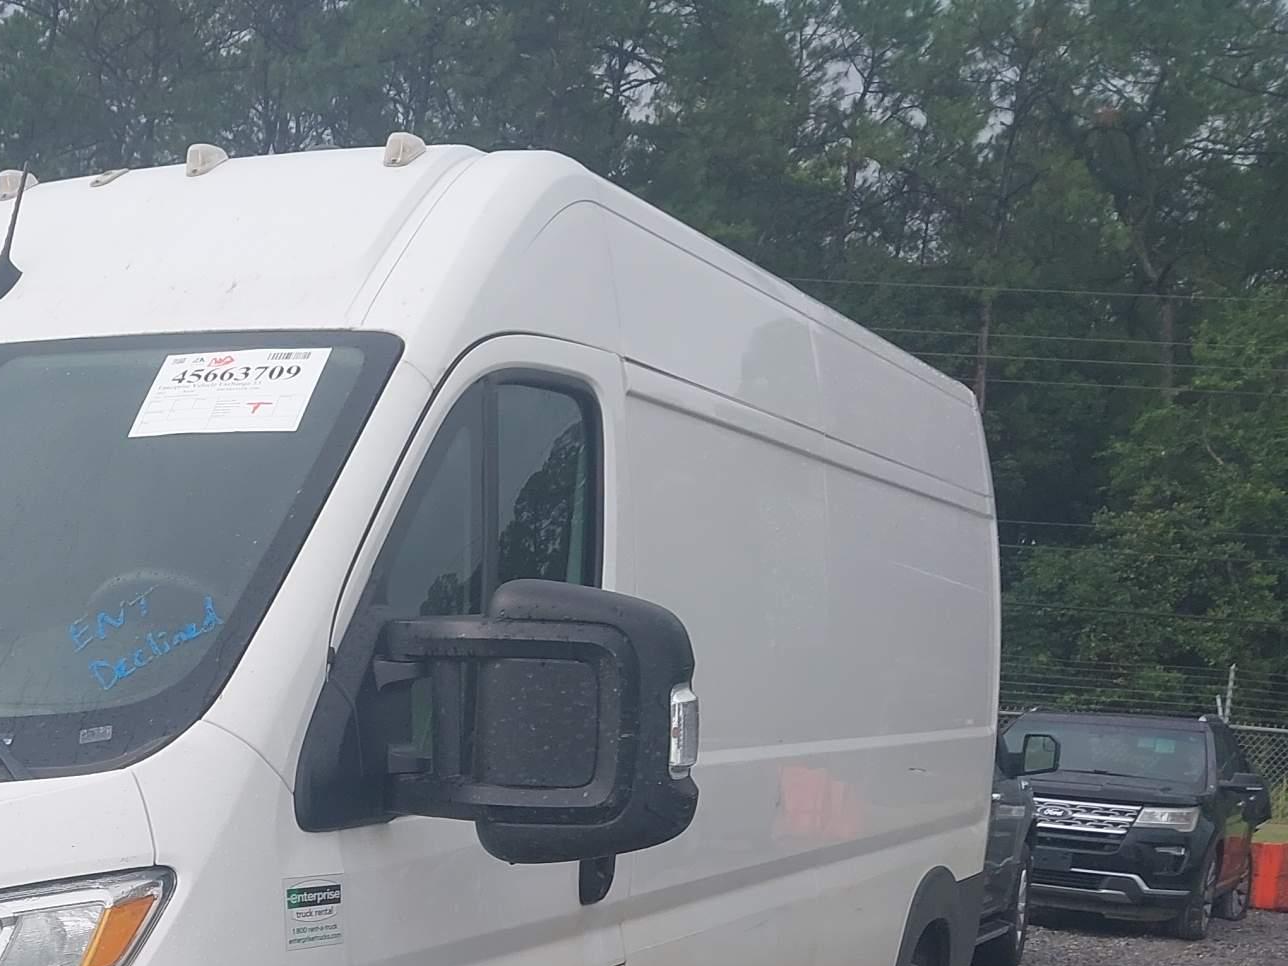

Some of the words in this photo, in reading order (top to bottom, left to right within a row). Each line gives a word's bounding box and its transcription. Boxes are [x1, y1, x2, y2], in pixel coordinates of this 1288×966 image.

[171, 365, 302, 384] 45663709
[290, 888, 341, 904] enterprise
[295, 908, 314, 918] truck
[315, 905, 334, 916] rental
